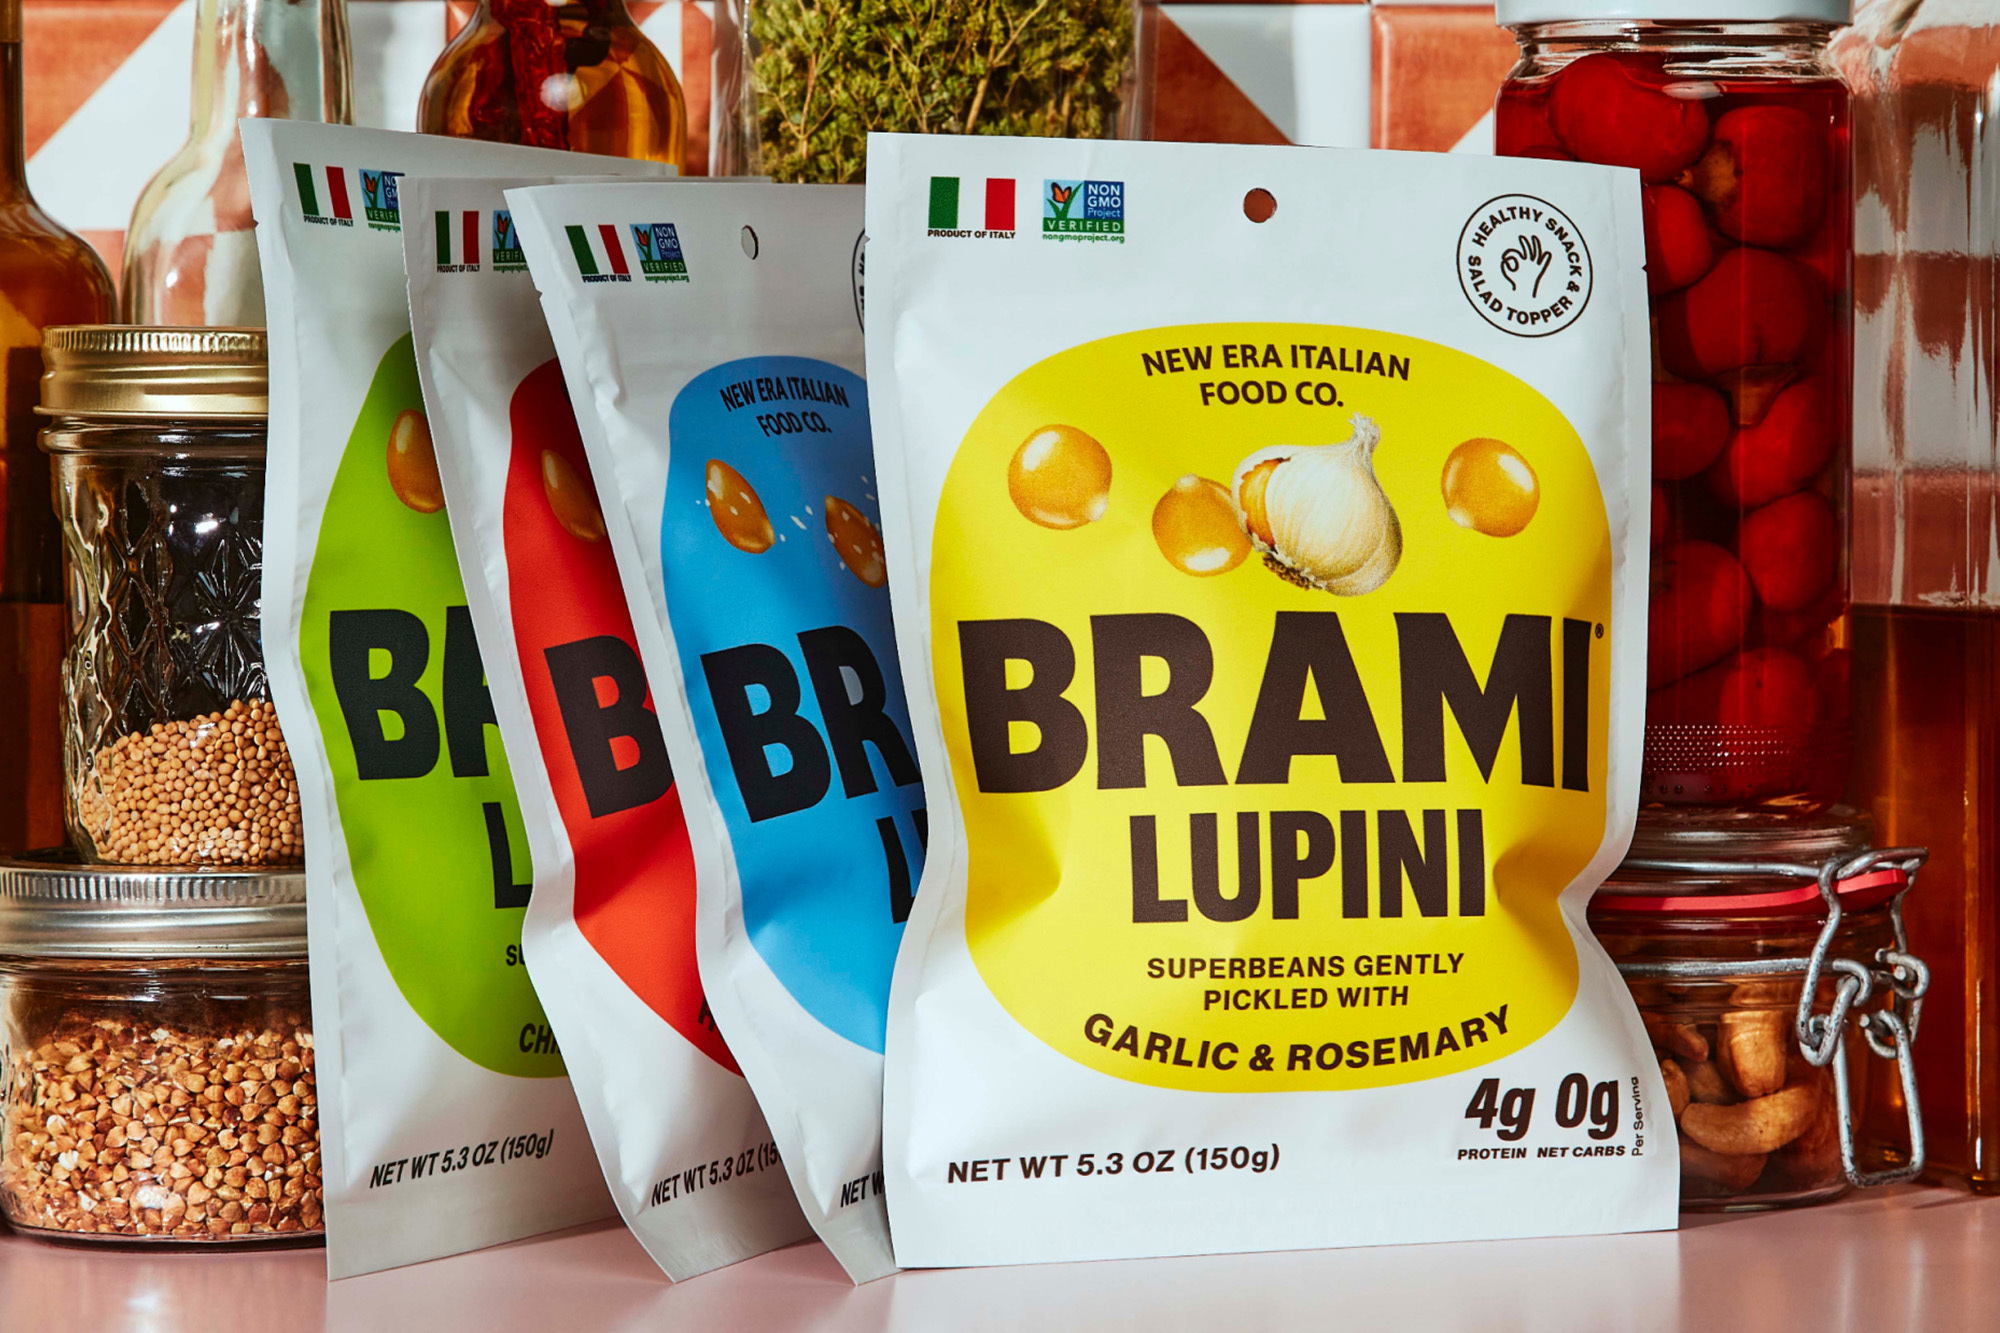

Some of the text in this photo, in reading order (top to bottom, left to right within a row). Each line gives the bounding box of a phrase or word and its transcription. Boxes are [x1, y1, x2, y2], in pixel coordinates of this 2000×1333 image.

[384, 175, 399, 186] NO
[385, 188, 399, 198] GM
[1088, 184, 1120, 196] NON
[1087, 196, 1121, 208] GMO
[368, 209, 399, 220] VERIFI
[1087, 208, 1121, 219] Project
[303, 215, 353, 227] PRODUCT OF ITALY
[1047, 220, 1121, 232] VERIFIED
[655, 226, 675, 238] NON
[927, 229, 1016, 240] PRODUCT OF ITALY
[1042, 233, 1125, 244] nongmoproject.org
[658, 238, 678, 249] GMO
[495, 251, 523, 262] VERIFI
[437, 264, 480, 273] PRODUCT OF ITALY
[643, 261, 684, 272] VERIFIED
[1468, 206, 1582, 325] HEALTHY SNACK & SALAD TOPPER
[582, 274, 632, 283] PRODUCT OF ITALY
[1142, 343, 1411, 381] NEW ERA ITALIAN
[719, 376, 850, 412] NEW ERA ITALIAN
[1199, 380, 1344, 407] FOOD CO.
[756, 411, 832, 437] FOOD CO.
[1129, 808, 1486, 923] LUPINI
[1147, 953, 1465, 978] SUPERBEANS GENTLY
[1203, 985, 1409, 1011] PICKLED WITH
[1083, 1004, 1509, 1072] GARLIC & ROSEMARY
[1464, 1072, 1619, 1142] 4g 0g
[1631, 1132, 1644, 1156] Per
[369, 1128, 554, 1189] NET WT 5.3 OZ (150g)
[1457, 1145, 1626, 1160] PROTEIN NET CARBS
[948, 1143, 1280, 1183] NET WT 5.3 OZ (150g)
[651, 1141, 782, 1207] NET WT 5.3 OZ (15
[840, 1170, 885, 1208] NET W
